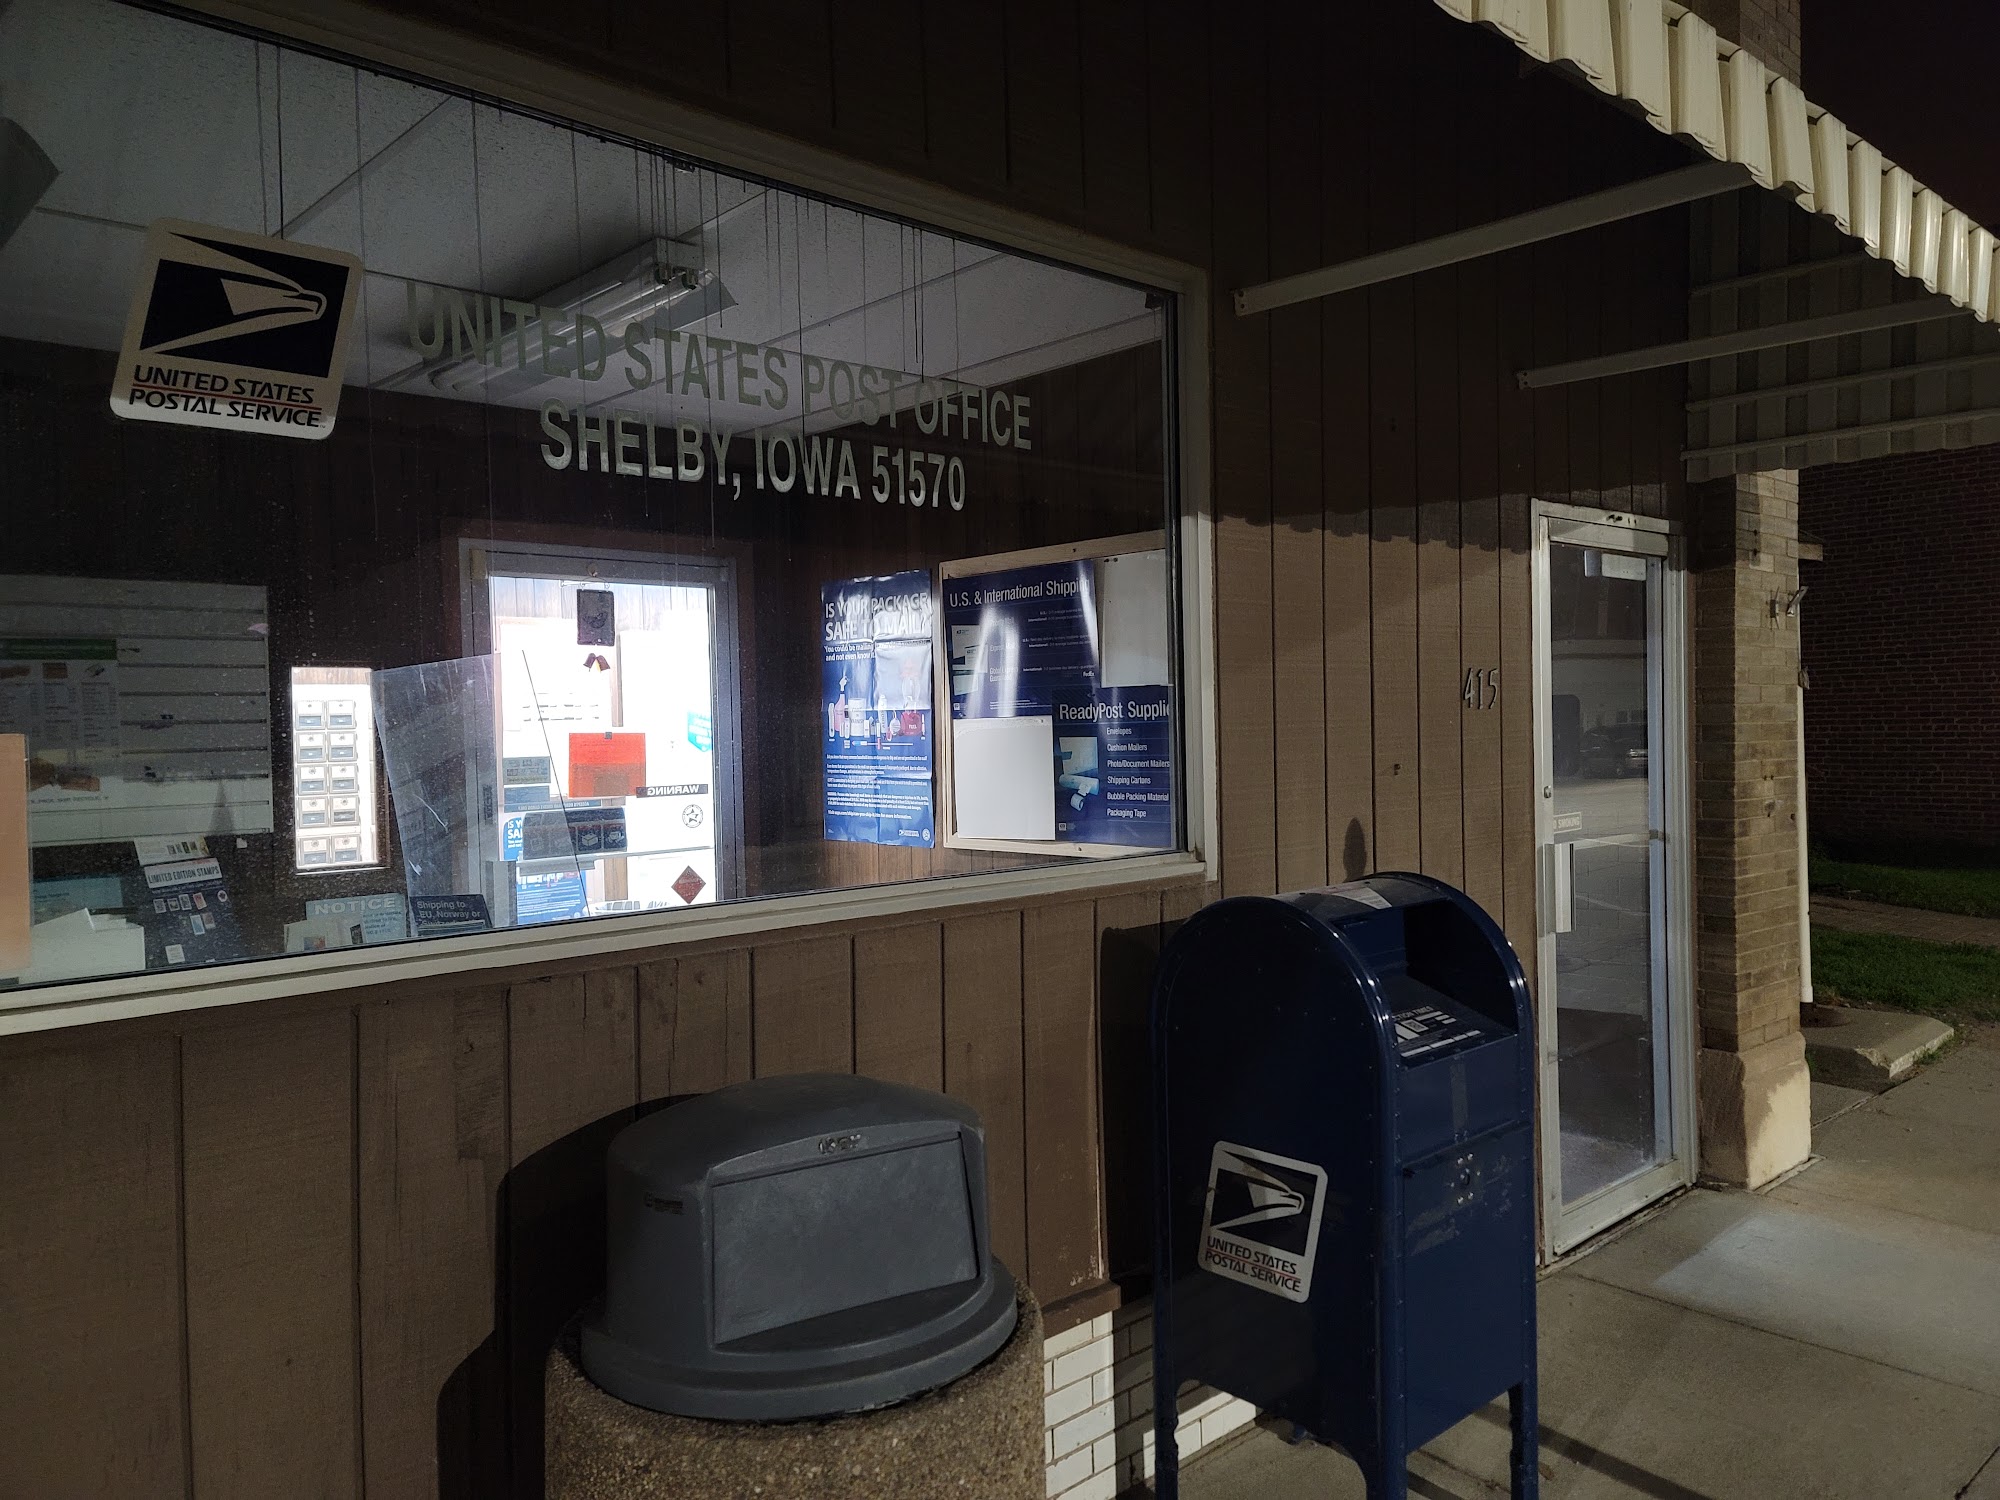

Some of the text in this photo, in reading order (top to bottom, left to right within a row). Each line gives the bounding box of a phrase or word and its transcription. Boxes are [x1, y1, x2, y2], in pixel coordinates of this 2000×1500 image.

[407, 282, 1032, 451] UNITED STATES POST OFFICE
[133, 364, 315, 404] UNITED STATES
[129, 388, 322, 428] POSTAL SERVICE
[540, 397, 966, 512] SHELBY, IOWA 51570
[950, 592, 973, 608] U.S.
[973, 590, 983, 605] &
[984, 580, 1043, 604] International
[825, 602, 836, 619] IS
[836, 595, 870, 617] YOUR
[825, 620, 858, 641] SAFE
[1463, 667, 1498, 710] 415
[1059, 701, 1124, 723] ReadyPost
[1107, 727, 1132, 736] Envelopes
[1107, 743, 1148, 752] Cushion Mailers
[1107, 775, 1152, 785] Shipping Cartons
[1107, 792, 1169, 802] Bubble Packing Material
[1107, 808, 1147, 819] Packaging Tape
[1558, 816, 1580, 829] SMOKING
[147, 866, 219, 884] LIMITED EDITION STAMPS
[314, 897, 396, 915] NOTICE
[416, 901, 454, 910] Shipping
[436, 910, 470, 919] Norway
[1207, 1236, 1297, 1275] UNITED STATES
[1205, 1250, 1302, 1292] POSTAL SERVICE
